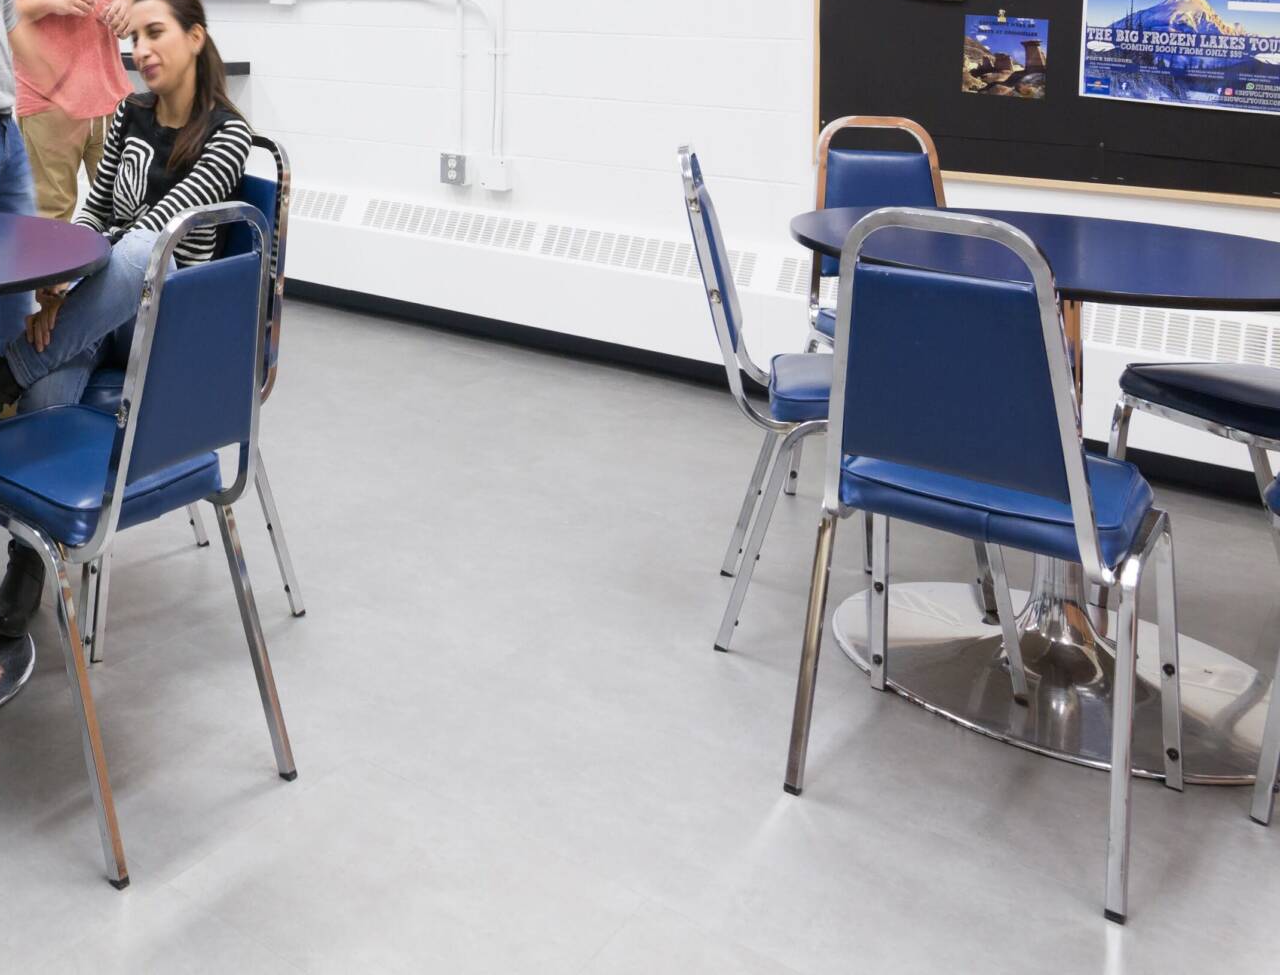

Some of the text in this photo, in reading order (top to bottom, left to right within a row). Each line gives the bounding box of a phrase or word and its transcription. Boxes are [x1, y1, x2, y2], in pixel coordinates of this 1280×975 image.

[1087, 27, 1113, 42] THE
[1116, 29, 1139, 43] BIG
[1142, 31, 1197, 47] FROZEN
[1200, 34, 1245, 50] LAKES
[1121, 43, 1154, 52] COMING
[1155, 45, 1177, 53] SOON
[1179, 47, 1203, 55] FROM
[1205, 49, 1227, 57] ONLY
